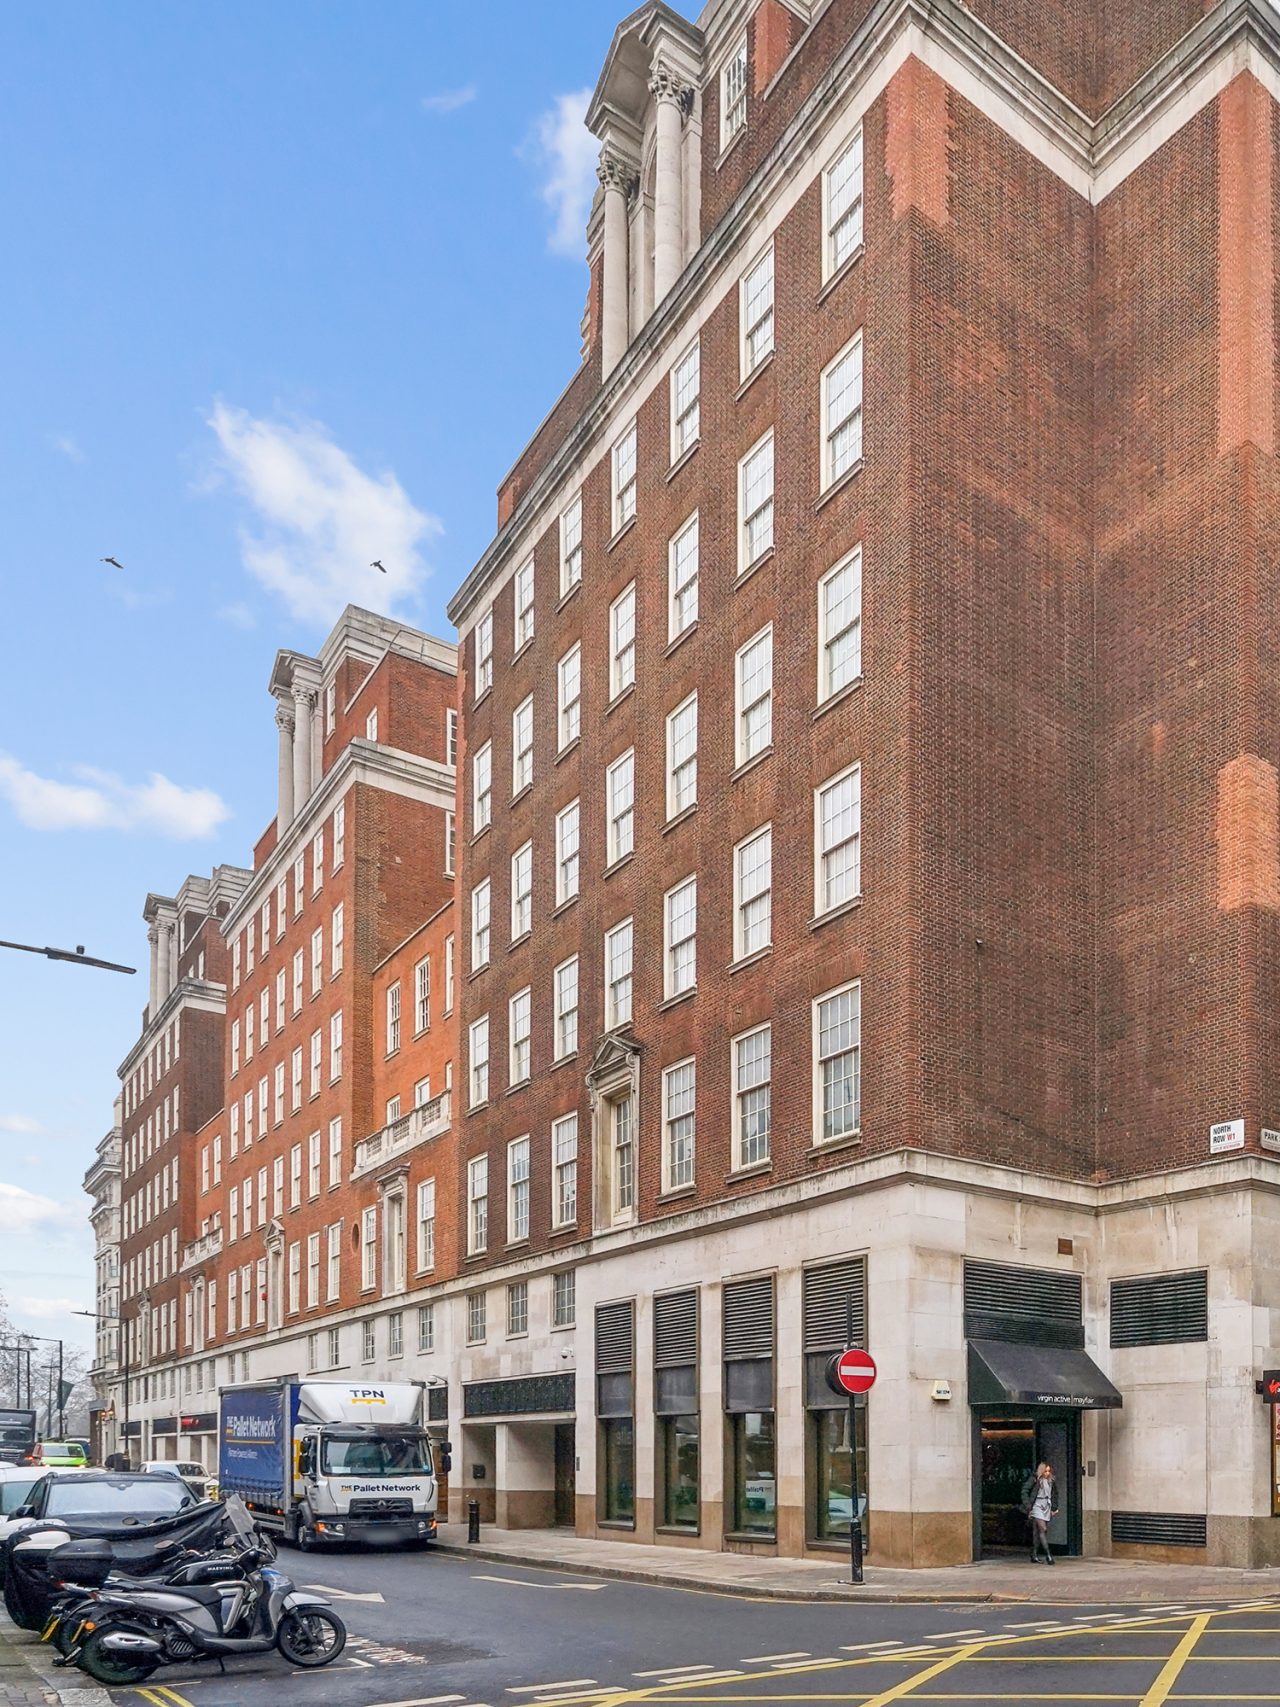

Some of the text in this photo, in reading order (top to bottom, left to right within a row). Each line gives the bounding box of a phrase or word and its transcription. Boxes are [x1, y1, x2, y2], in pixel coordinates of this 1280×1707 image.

[1213, 1125, 1231, 1135] NORTH
[1213, 1133, 1235, 1143] ROW W1
[1264, 1131, 1279, 1142] PARK
[350, 1389, 385, 1398] TPN
[1037, 1395, 1095, 1404] virgin active mayfair
[233, 1415, 249, 1436] Pallet
[249, 1415, 276, 1437] Network
